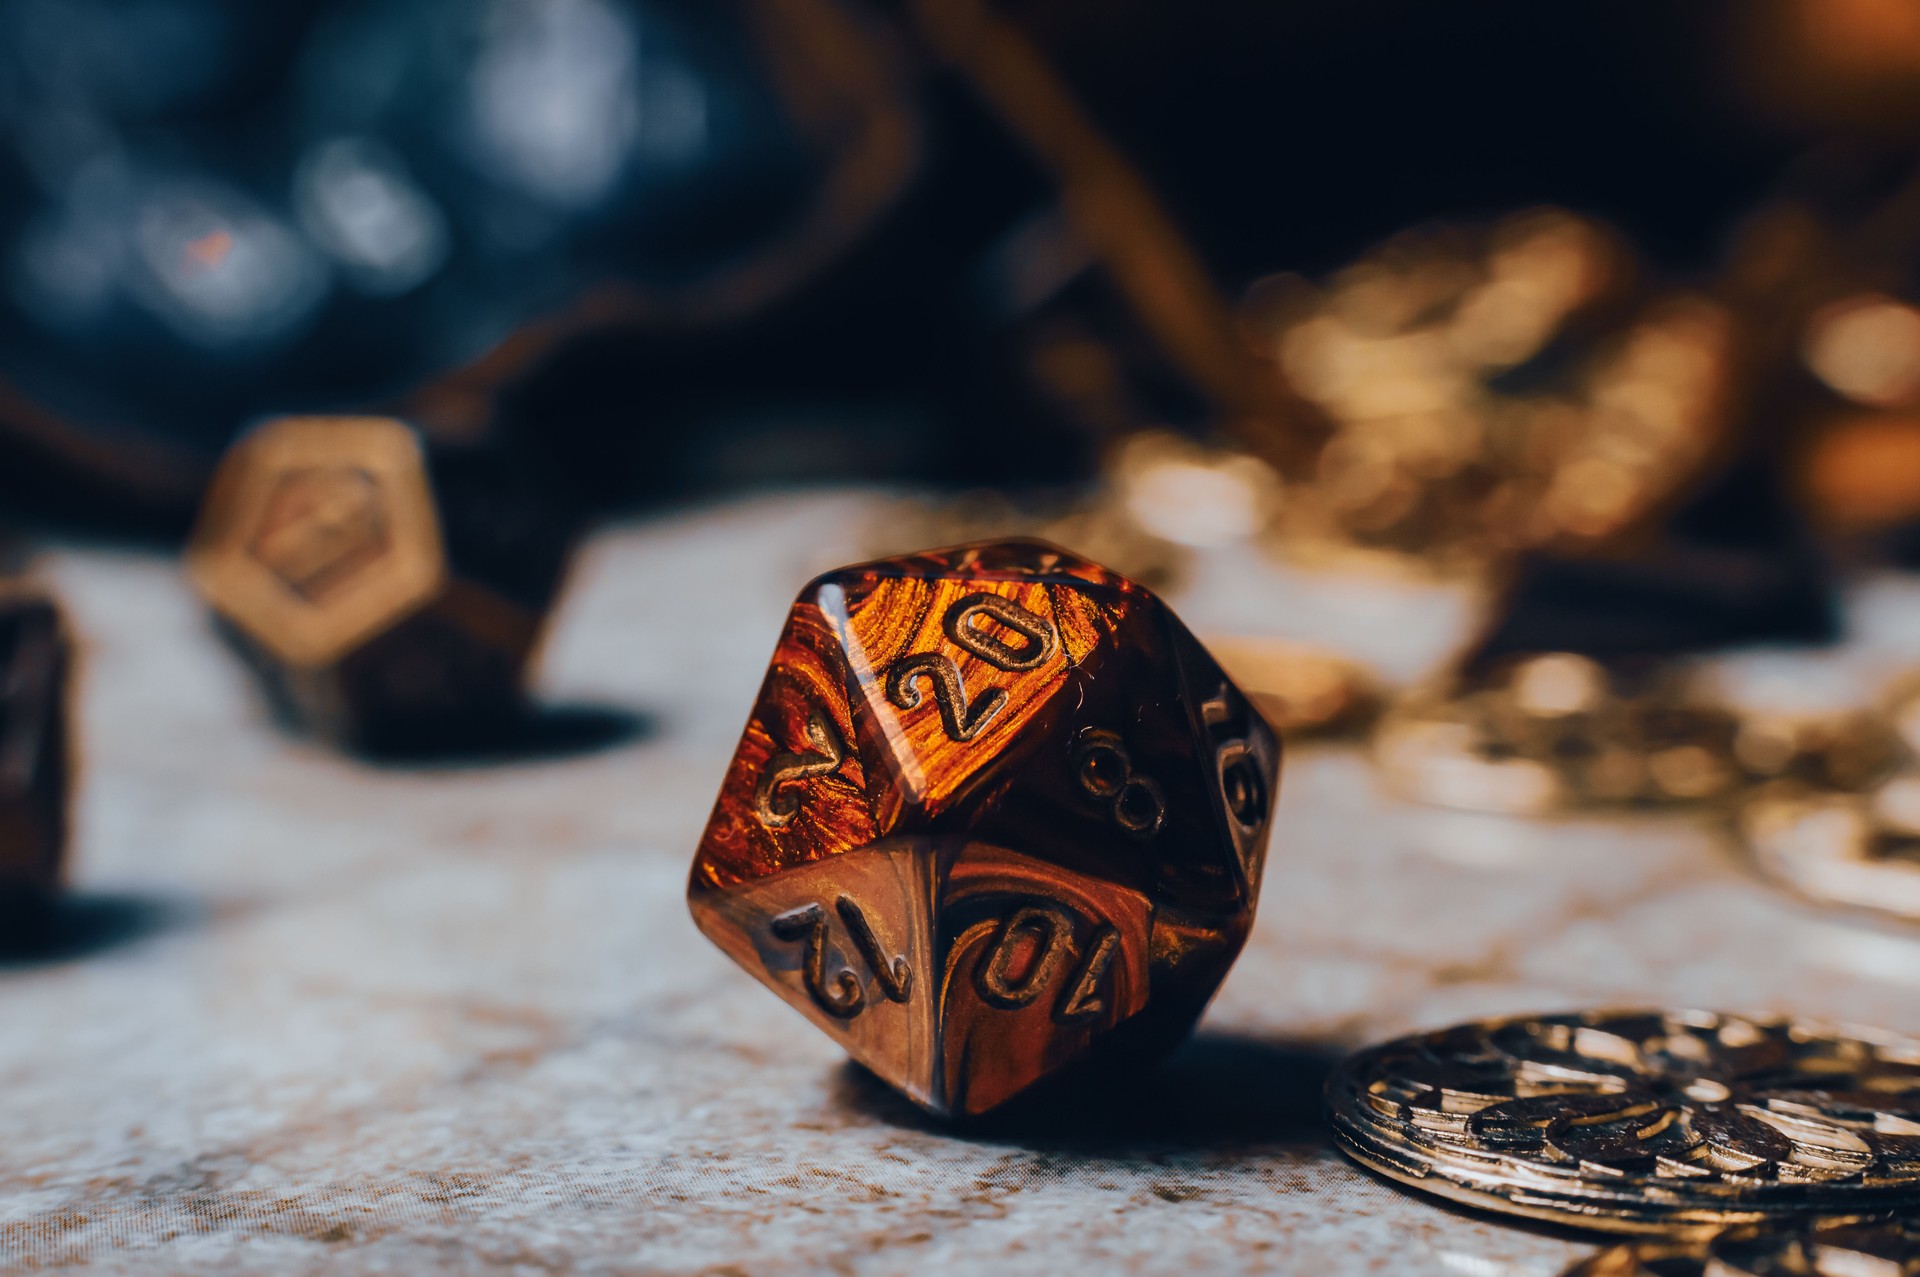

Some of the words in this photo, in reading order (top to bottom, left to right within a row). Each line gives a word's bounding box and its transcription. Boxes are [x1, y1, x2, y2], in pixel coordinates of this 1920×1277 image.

[886, 592, 1059, 742] 20
[755, 709, 843, 828] 2
[1078, 735, 1166, 837] 8
[770, 895, 913, 1019] 12
[976, 901, 1121, 1023] 10
